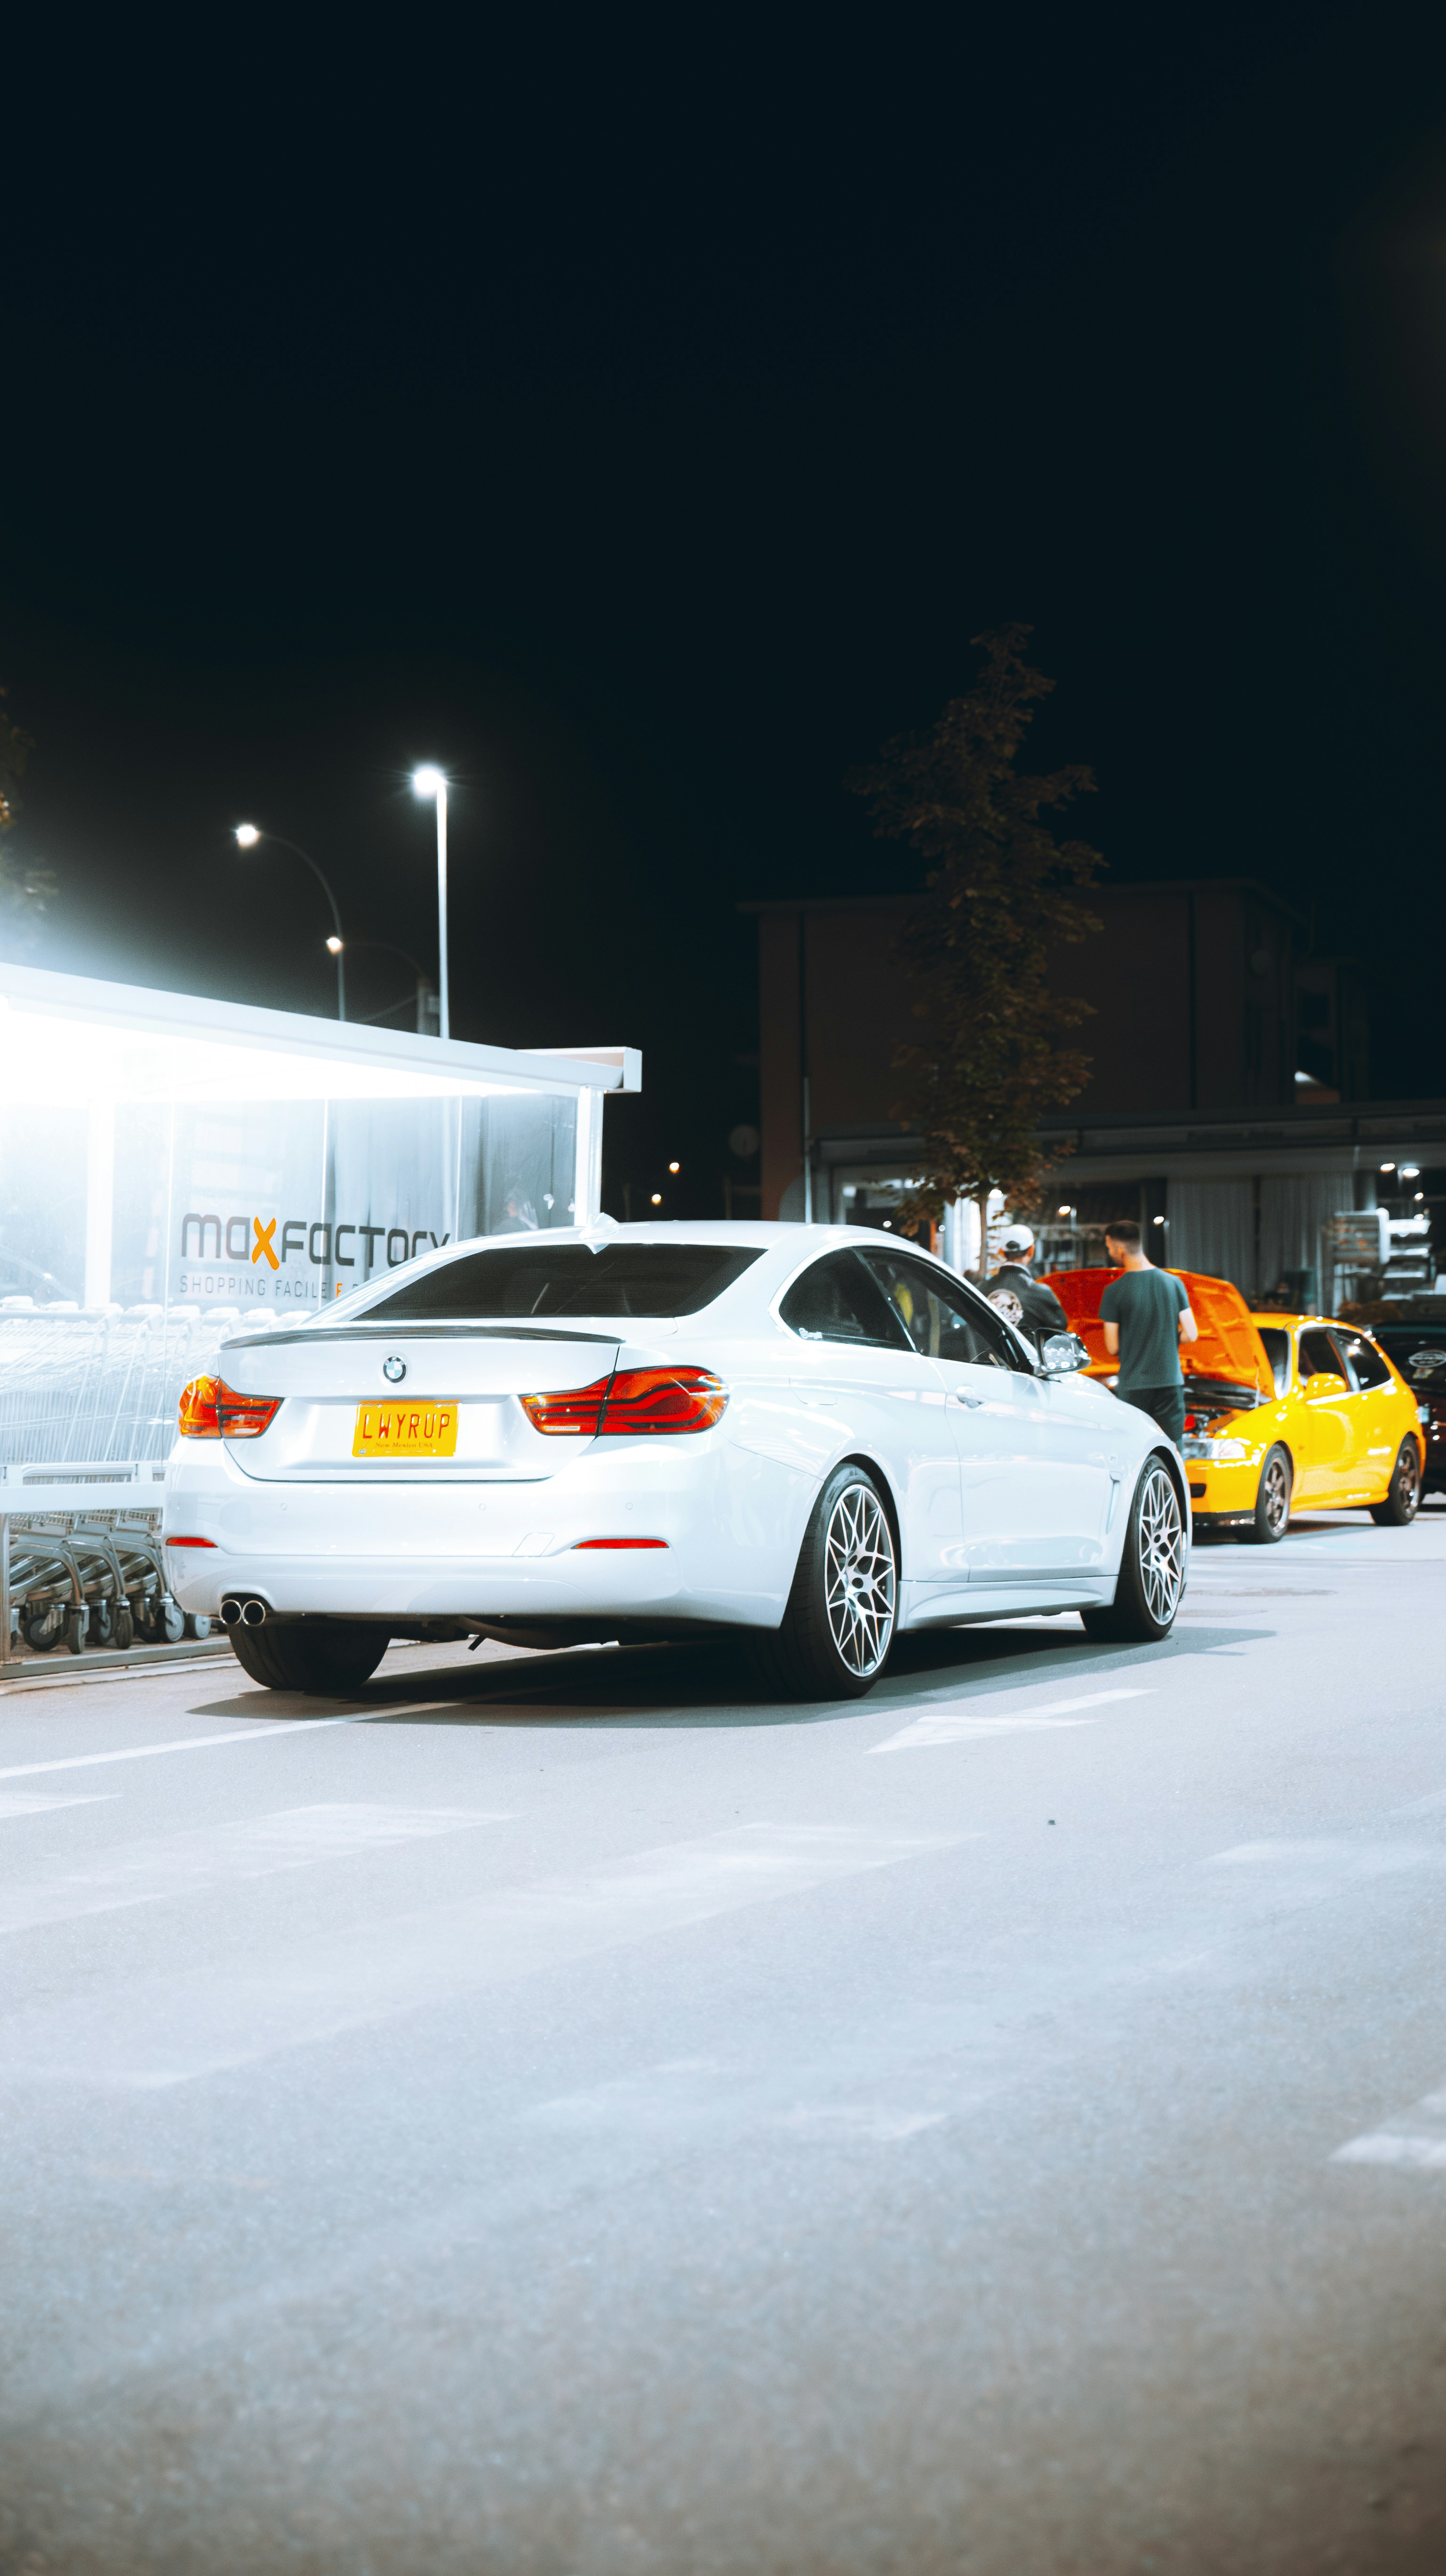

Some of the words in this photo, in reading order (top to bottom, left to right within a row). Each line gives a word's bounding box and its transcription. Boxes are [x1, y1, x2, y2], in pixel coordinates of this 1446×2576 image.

[180, 1276, 265, 1296] SHOPPING
[275, 1280, 329, 1299] FACILE
[362, 1414, 450, 1439] LWYRUP
